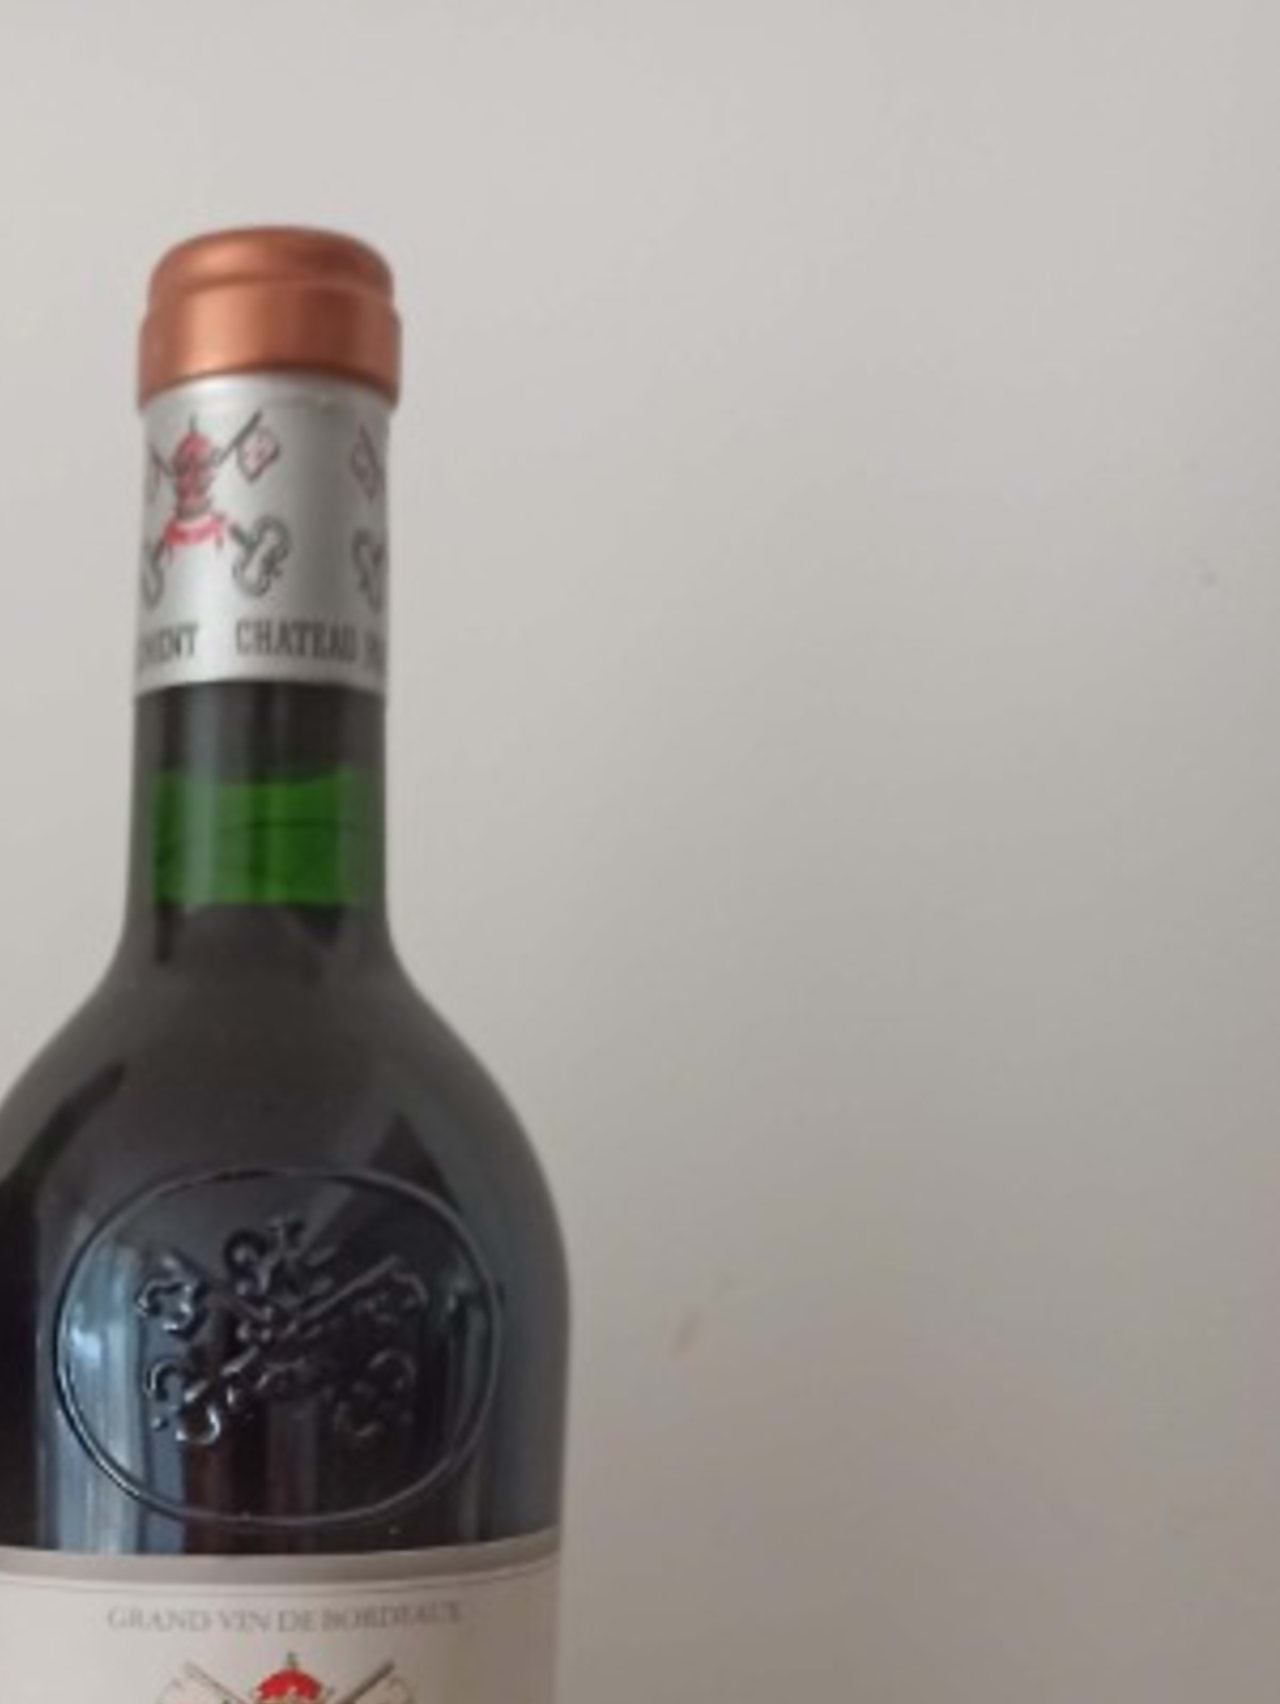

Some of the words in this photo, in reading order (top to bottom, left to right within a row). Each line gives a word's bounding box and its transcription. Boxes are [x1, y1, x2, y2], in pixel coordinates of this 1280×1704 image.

[235, 617, 358, 665] CHATEAU
[106, 1605, 213, 1634] GRAND
[218, 1606, 271, 1633] VIN
[277, 1607, 319, 1633] DE
[322, 1599, 464, 1632] BORDEAUX
